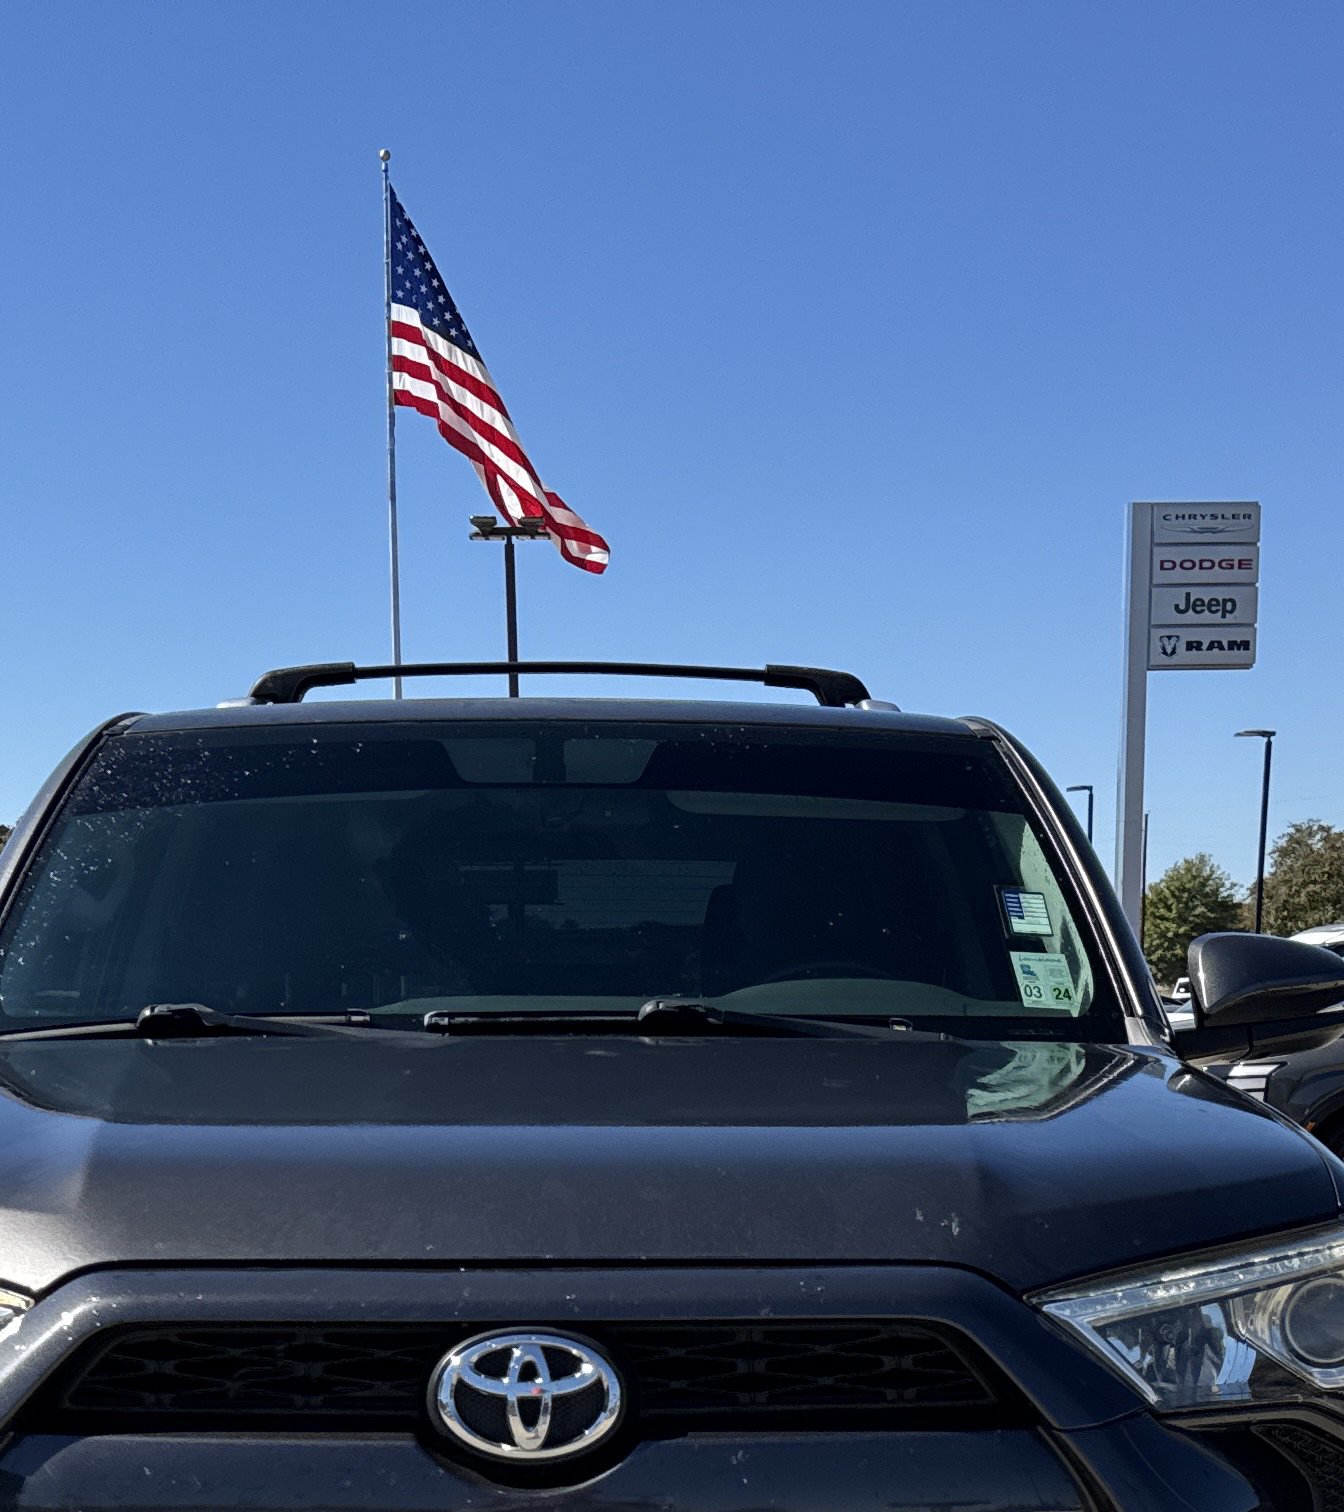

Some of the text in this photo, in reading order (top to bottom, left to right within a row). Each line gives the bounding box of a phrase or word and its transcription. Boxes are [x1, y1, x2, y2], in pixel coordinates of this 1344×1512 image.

[1162, 513, 1253, 521] CHRYSLER
[1159, 558, 1254, 571] DODGE
[1174, 591, 1237, 619] Jeep
[1185, 639, 1251, 651] RAM
[1023, 984, 1072, 1001] 03 24
